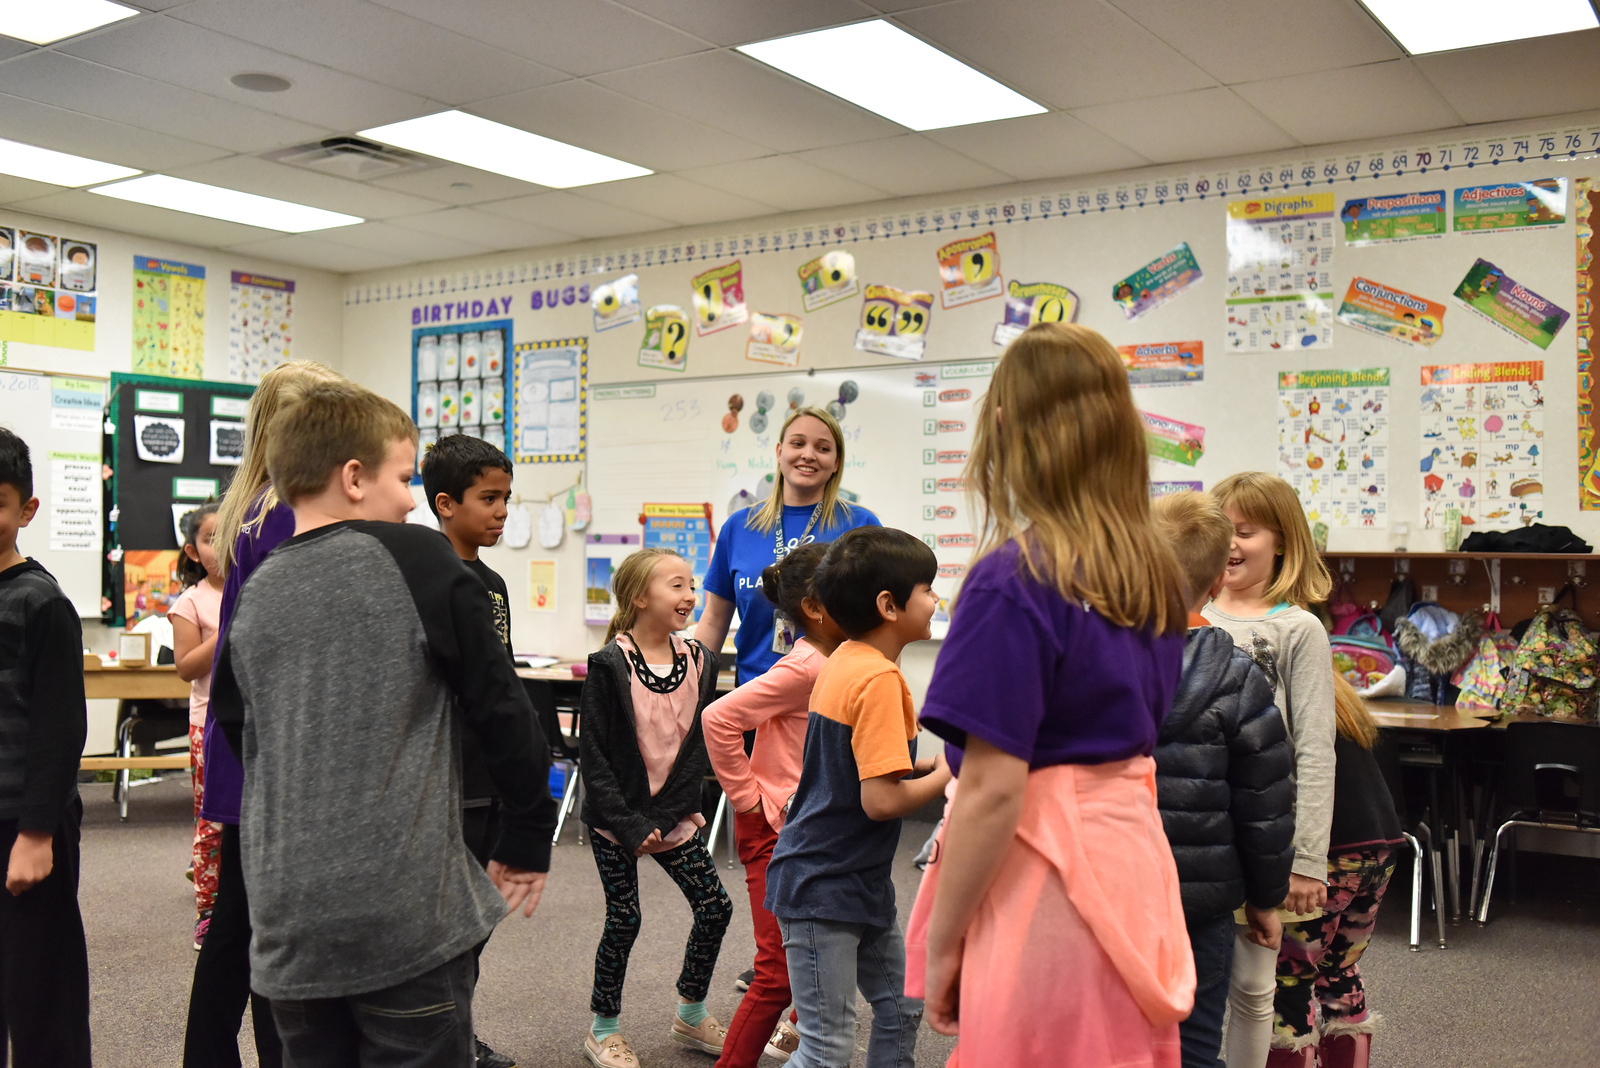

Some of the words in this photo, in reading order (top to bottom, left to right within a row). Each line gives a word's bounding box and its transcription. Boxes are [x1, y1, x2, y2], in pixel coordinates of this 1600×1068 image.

[967, 209, 980, 221] 48
[985, 207, 998, 219] 49
[1003, 204, 1015, 218] 50
[1020, 202, 1032, 215] 51
[1039, 200, 1053, 213] 52
[1058, 198, 1071, 211] 53
[1077, 195, 1090, 209] 54
[1096, 192, 1110, 206] 55
[1115, 190, 1129, 204] 56
[1135, 188, 1149, 201] 57
[1155, 185, 1169, 199] 58
[1175, 182, 1189, 196] 59
[1196, 180, 1210, 194] 60
[1217, 177, 1229, 191] 61
[1238, 175, 1252, 188] 62
[1259, 172, 1273, 185] 63
[1280, 169, 1294, 183] 64
[1302, 166, 1316, 180] 65
[1324, 164, 1339, 177] 66
[1346, 161, 1361, 175] 67
[1369, 158, 1384, 172] 68
[1393, 155, 1408, 169] 69
[1417, 152, 1432, 167] 70
[1440, 150, 1452, 164] 71
[1464, 146, 1479, 161] 72
[1489, 144, 1504, 158] 73
[1514, 141, 1529, 155] 74
[1540, 138, 1556, 153] 75
[1565, 135, 1582, 150] 76
[1461, 186, 1526, 202] Adjectives
[1264, 197, 1313, 215] Digraphs
[1367, 194, 1441, 211] Prepositions
[939, 234, 995, 262] Apostrophe
[160, 261, 188, 276] Vowels
[1147, 254, 1177, 274] Verbs
[1009, 281, 1069, 300] Parentheses
[1356, 280, 1428, 313] Conjunctions
[1511, 284, 1547, 311] Nouns
[411, 296, 512, 326] BIRTHDAY
[531, 284, 590, 311] BUGS
[667, 322, 685, 360] ?
[1136, 345, 1178, 358] Adverbs
[1299, 373, 1348, 388] Beginning
[1352, 371, 1386, 382] Blends
[1453, 368, 1492, 383] Ending
[1494, 365, 1531, 379] Blends
[9, 375, 40, 392] 2018
[55, 395, 83, 406] Creative
[83, 397, 101, 408] Ideas
[939, 391, 970, 401] clothes
[660, 399, 702, 422] 253
[939, 422, 964, 430] hours
[1505, 443, 1520, 451] mp
[748, 456, 774, 470] Nickel
[939, 454, 968, 463] money
[64, 474, 92, 482] original
[56, 508, 98, 516] opportunity
[658, 507, 677, 516] Money
[936, 507, 955, 517] only
[680, 844, 699, 856] Couture
[689, 859, 707, 869] Juicy
[677, 868, 696, 886] Couture
[699, 896, 718, 906] Couture
